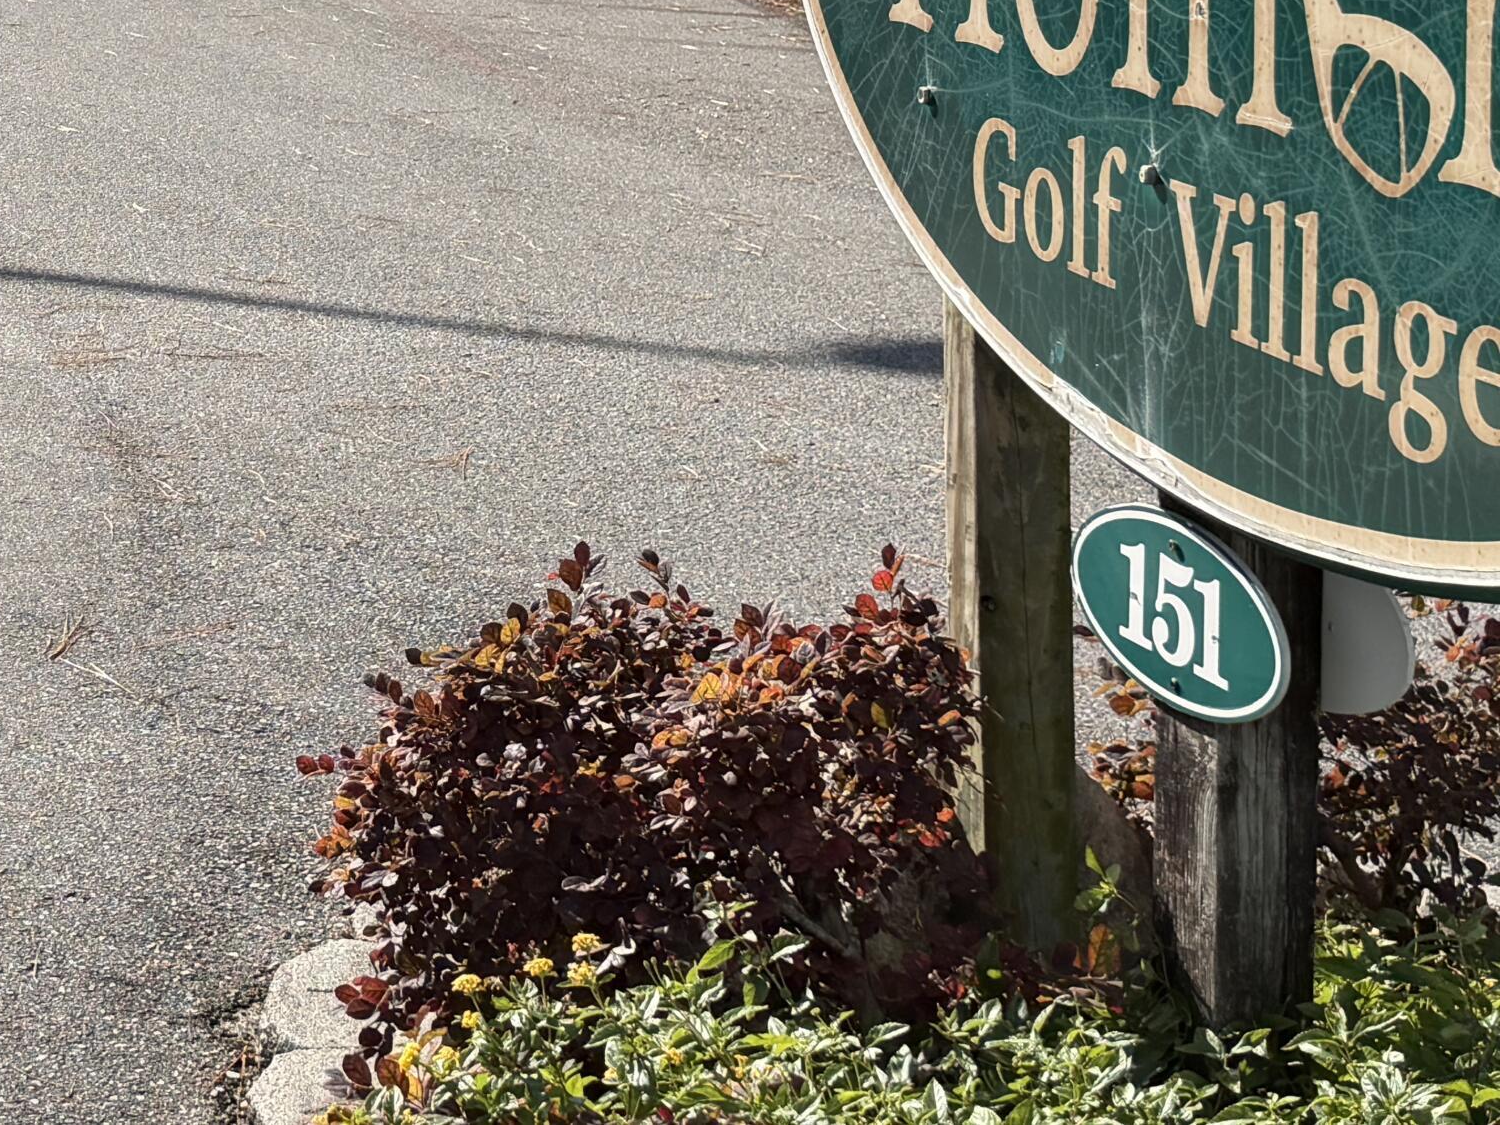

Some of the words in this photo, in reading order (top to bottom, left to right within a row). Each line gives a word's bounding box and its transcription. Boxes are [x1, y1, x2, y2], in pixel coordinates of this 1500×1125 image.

[972, 117, 1128, 288] Golf
[1168, 179, 1500, 464] Village
[1118, 543, 1229, 691] 151
